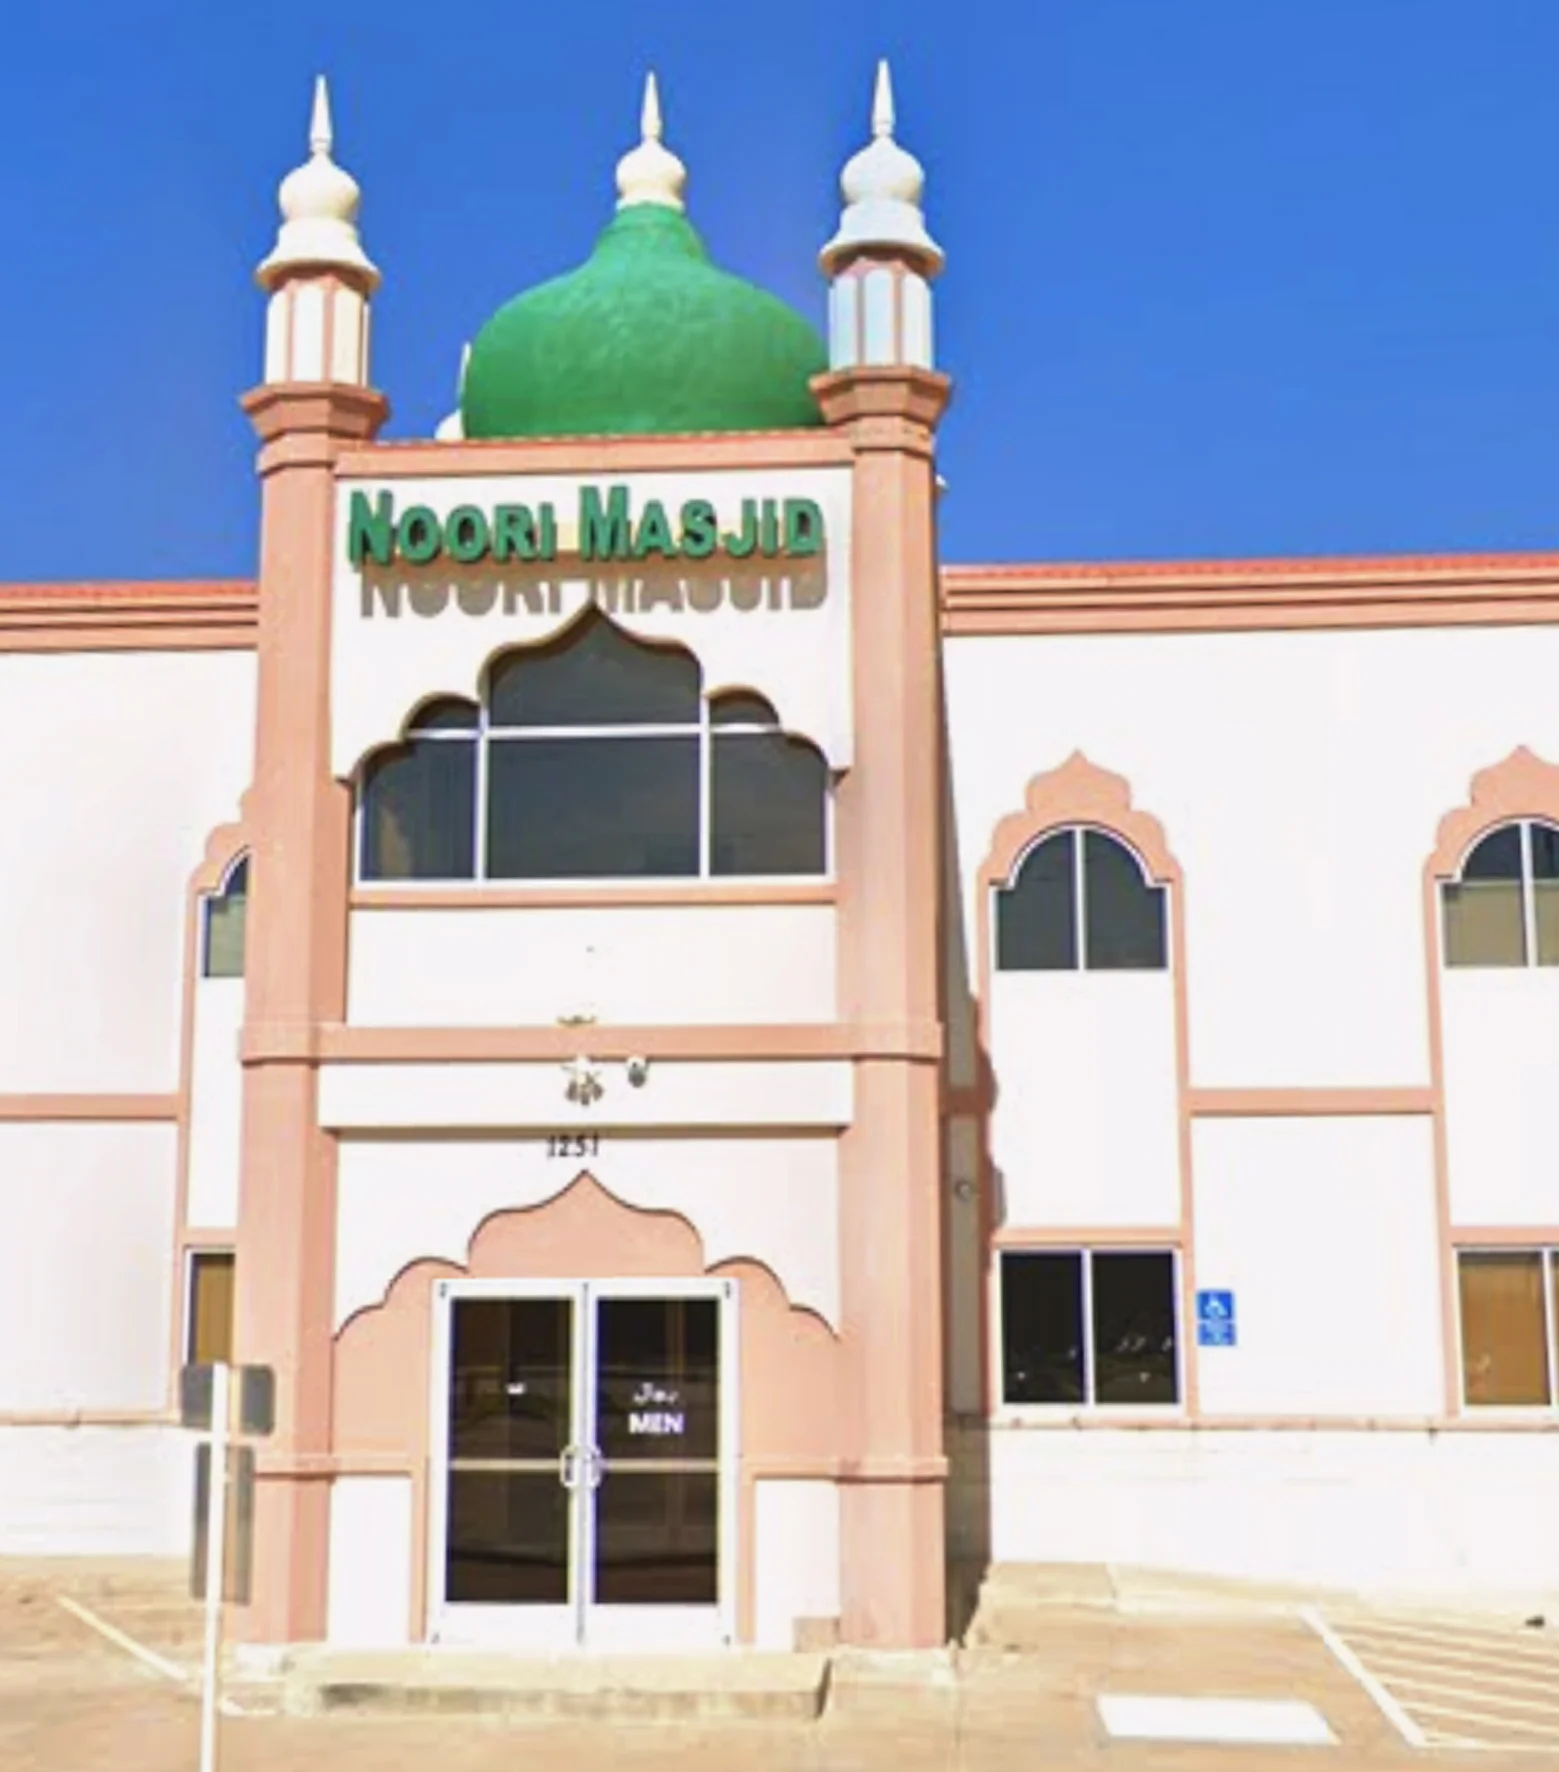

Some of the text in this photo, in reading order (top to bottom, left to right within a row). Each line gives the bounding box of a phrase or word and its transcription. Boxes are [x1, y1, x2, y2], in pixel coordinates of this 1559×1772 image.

[348, 485, 825, 567] NOORI MASJID
[548, 1133, 599, 1157] 1251
[628, 1413, 685, 1435] MEN
